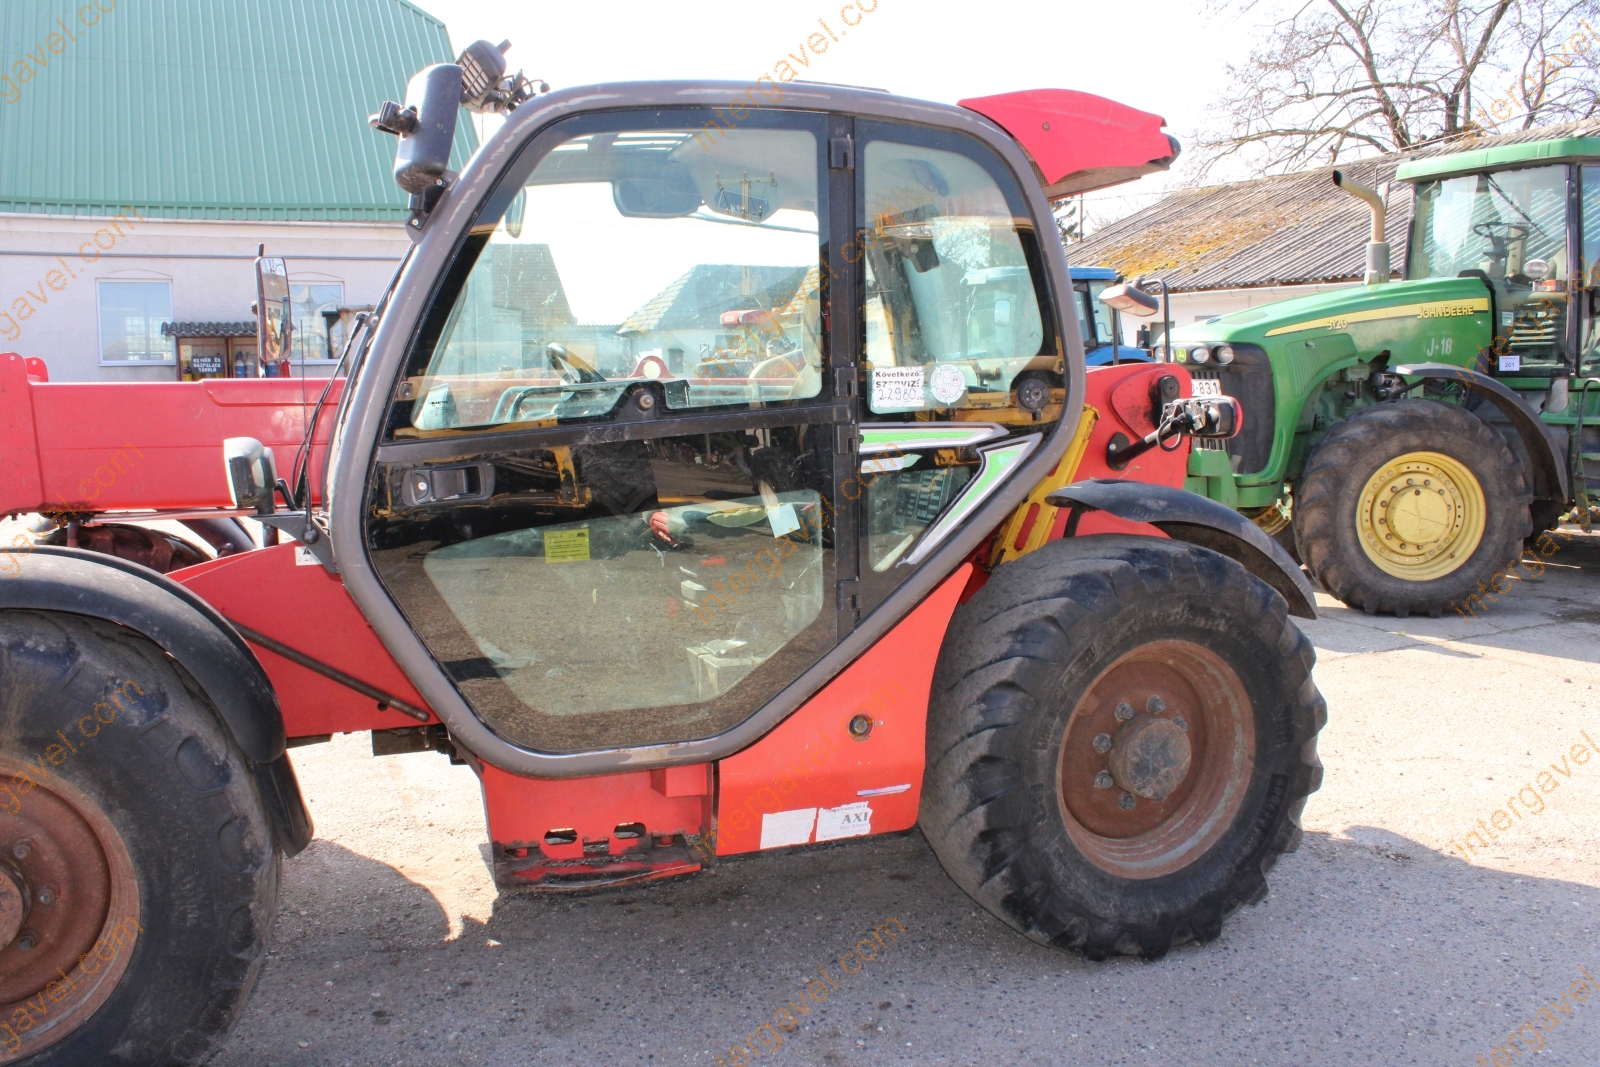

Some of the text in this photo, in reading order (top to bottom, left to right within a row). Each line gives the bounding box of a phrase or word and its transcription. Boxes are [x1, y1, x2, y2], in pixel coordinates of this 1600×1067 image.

[1417, 304, 1475, 319] JOHN DEERE
[878, 388, 917, 400] 22980
